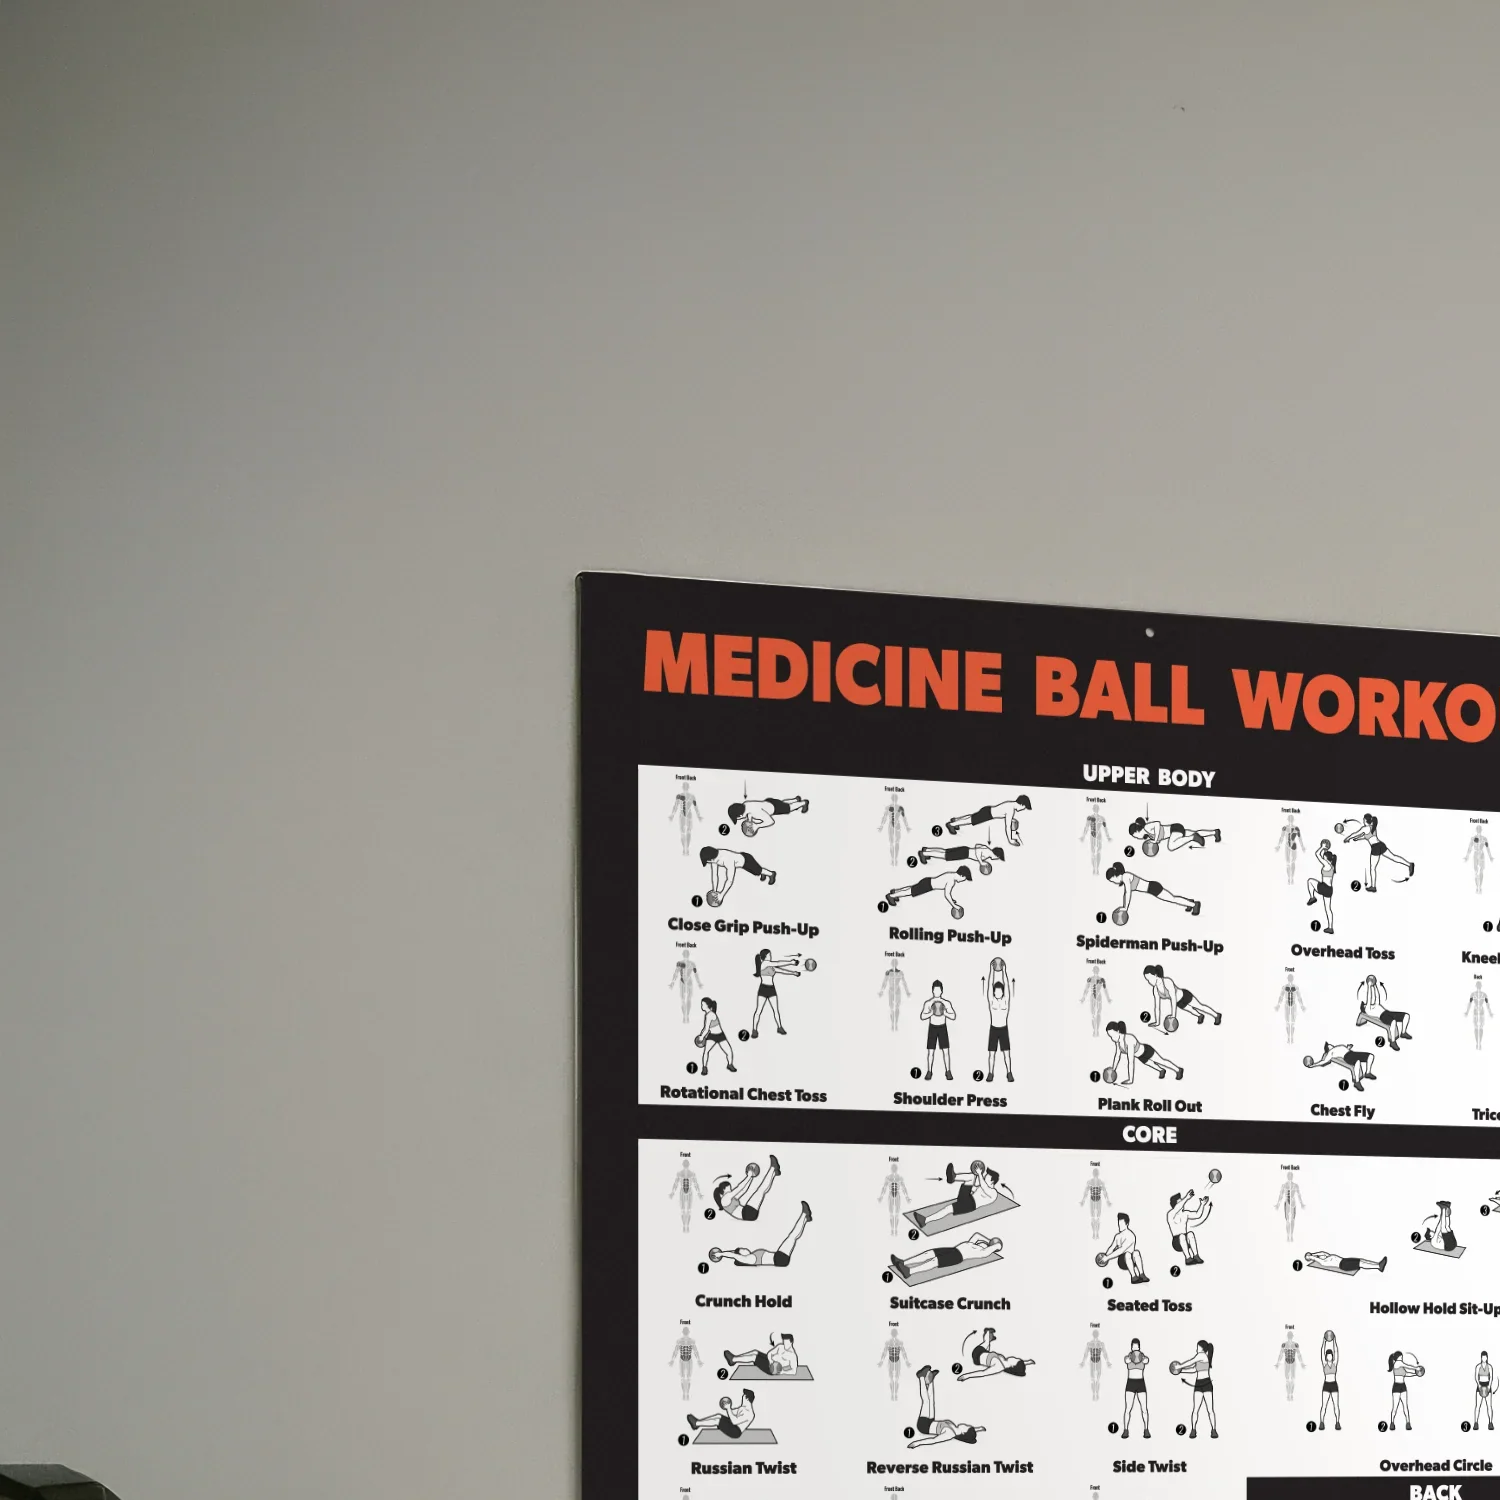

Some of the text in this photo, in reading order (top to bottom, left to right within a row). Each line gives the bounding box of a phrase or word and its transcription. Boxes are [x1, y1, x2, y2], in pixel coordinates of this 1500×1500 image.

[644, 630, 1002, 713] MEDICINE
[1035, 655, 1205, 726] BALL
[1083, 764, 1216, 788] UPPER BODY
[668, 917, 819, 939] Close Grip Push-Up
[889, 927, 1012, 947] Rolling Push-Up
[1076, 935, 1224, 955] Spiderman Push-Up
[1291, 944, 1395, 960] Overhead Toss
[660, 1085, 827, 1102] Rotational Chest Toss
[893, 1092, 1007, 1107] Shoulder Press
[1098, 1098, 1202, 1112] Plank Roll Out
[1311, 1104, 1375, 1120] Chest Fly
[1122, 1125, 1177, 1143] CORE
[695, 1294, 792, 1308] Crunch Hold
[890, 1296, 1011, 1310] Suitcase Crunch
[1107, 1299, 1192, 1312] Seated Toss
[1370, 1302, 1420, 1314] Hollow
[1423, 1302, 1456, 1314] Hold
[691, 1461, 797, 1474] Russian Twist
[867, 1460, 1033, 1474] Reverse Russian Twist
[1113, 1460, 1187, 1473] Side Twist
[1380, 1459, 1493, 1471] Overhead Circle
